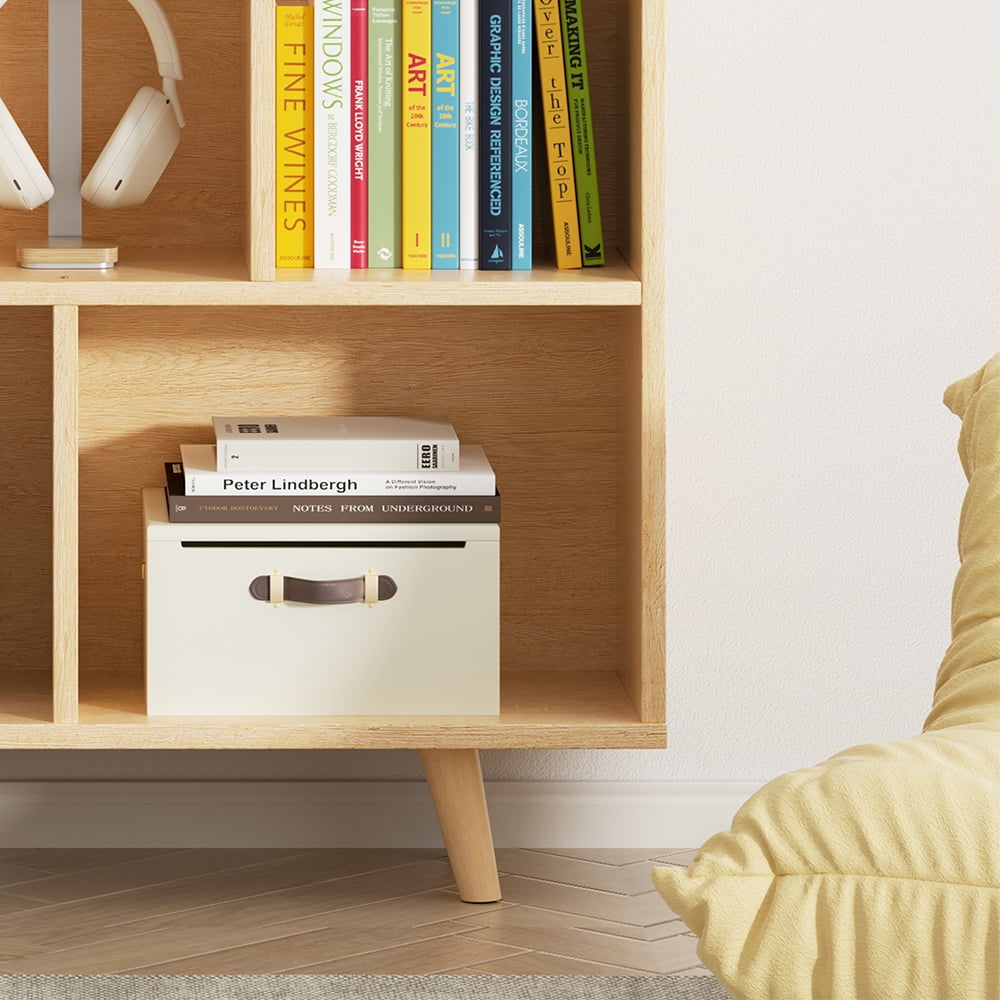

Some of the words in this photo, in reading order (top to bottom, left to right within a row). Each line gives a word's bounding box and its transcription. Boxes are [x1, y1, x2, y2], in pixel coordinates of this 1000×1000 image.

[490, 14, 502, 73] GRAPHIC
[564, 0, 582, 69] MAKING
[284, 43, 306, 112] FINE
[385, 54, 393, 65] Art
[408, 53, 426, 96] ART
[436, 52, 455, 96] ART
[354, 80, 364, 110] FRANK
[490, 77, 502, 125] DESIGN
[550, 77, 562, 125] the
[571, 73, 584, 90] IT
[327, 122, 338, 168] BERGDORF
[354, 112, 364, 142] LLOYD
[406, 121, 428, 129] Century
[434, 121, 457, 129] Century
[514, 99, 529, 172] BORDEAUX
[284, 127, 306, 231] WINES
[354, 143, 364, 181] WRIGHT
[490, 130, 502, 216] REFERENCED
[553, 142, 568, 199] Top
[327, 169, 338, 217] GOODMAN
[563, 221, 572, 256] ASSOULINE
[421, 444, 431, 469] EERO
[223, 478, 267, 491] Peter
[272, 478, 358, 493] Lindbergh
[199, 504, 228, 512] FYODOR
[230, 504, 279, 512] DOSTOEVSKY
[292, 503, 333, 513] NOTES
[340, 503, 374, 513] FROM
[381, 503, 473, 513] UNDERGROUND
